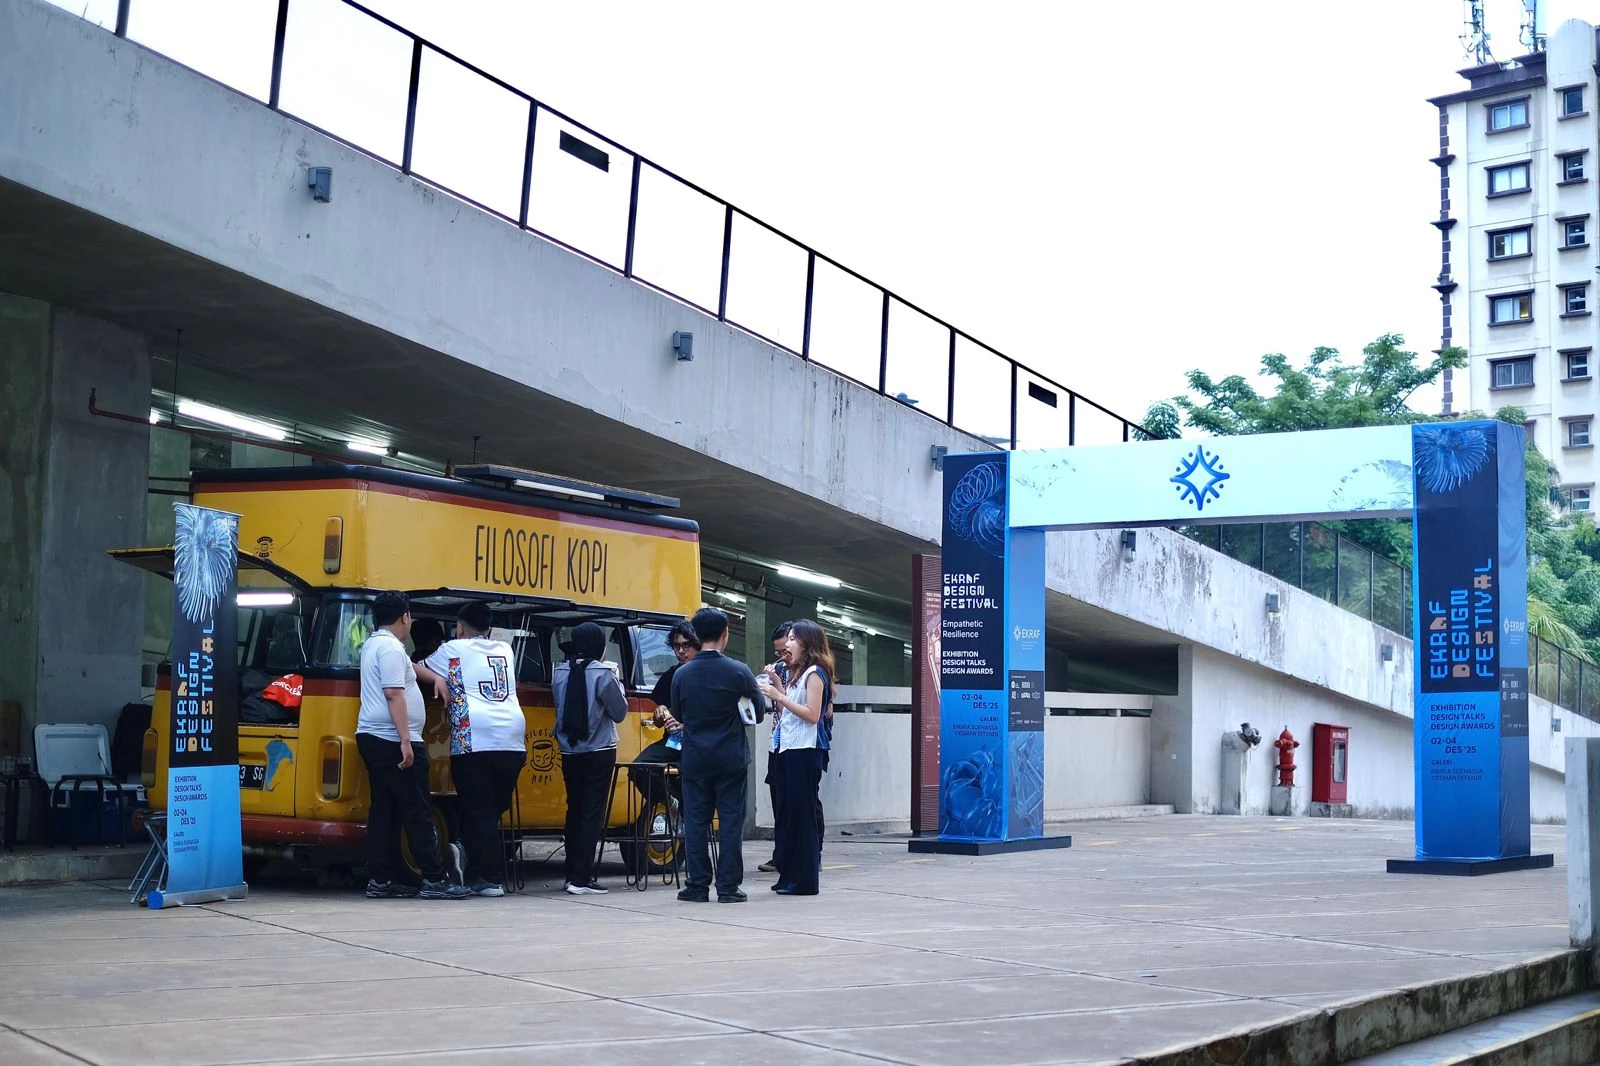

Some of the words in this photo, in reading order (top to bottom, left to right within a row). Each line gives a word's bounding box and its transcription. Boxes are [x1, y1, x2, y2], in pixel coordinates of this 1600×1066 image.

[475, 525, 554, 591] FILOSOFI
[567, 537, 607, 596] KOPI
[943, 573, 980, 584] EKRAF
[943, 585, 985, 596] DESIGN
[943, 598, 999, 609] FESTIVAL
[1474, 558, 1494, 677] FESTIVAL
[942, 620, 984, 629] Empathetic
[942, 630, 979, 638] Resilience
[1021, 629, 1041, 639] EKRAF
[1451, 589, 1470, 678] DESIGN
[1429, 601, 1448, 678] EKRAF
[942, 650, 979, 658] EXHIBITION
[478, 656, 509, 702] J
[201, 619, 214, 752] FESTIVAL
[187, 652, 200, 752] DESIGN
[961, 693, 983, 701] 02-04
[176, 662, 188, 752] EKRAF
[1430, 703, 1476, 711] EXHIBITION
[1461, 722, 1495, 730] AWARDS
[1430, 737, 1457, 745] 02-04
[1445, 746, 1463, 754] DES
[173, 809, 187, 817] 02-04
[180, 817, 190, 825] DES
